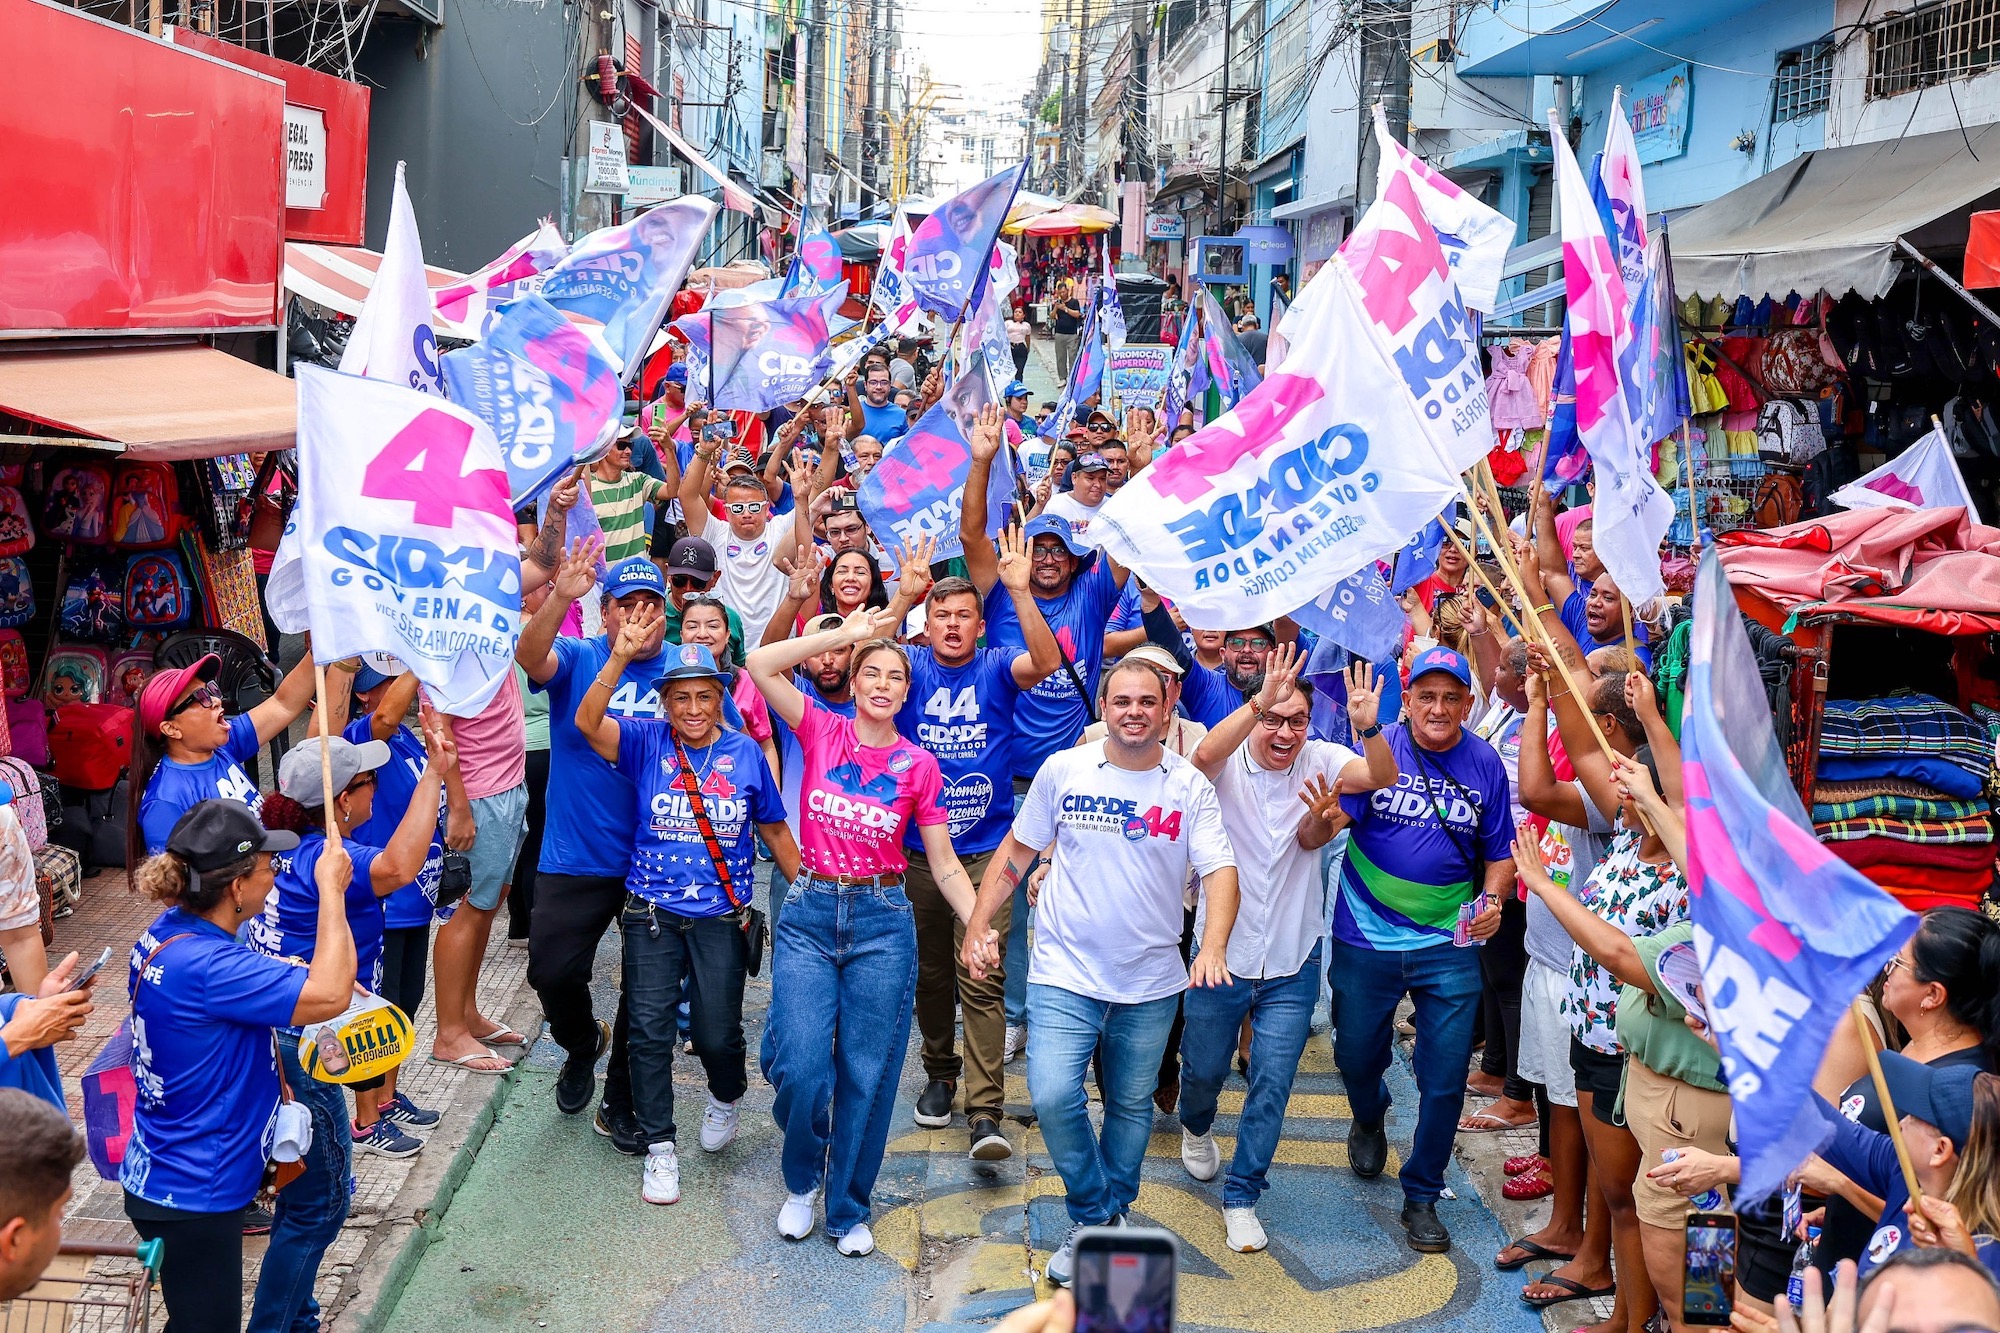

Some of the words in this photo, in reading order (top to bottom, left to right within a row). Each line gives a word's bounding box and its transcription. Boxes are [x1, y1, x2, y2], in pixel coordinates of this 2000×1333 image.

[285, 121, 309, 146] EGAL
[286, 149, 315, 173] PRESS
[629, 175, 677, 187] Mundinho
[1156, 217, 1176, 225] Baby
[1158, 224, 1177, 232] Toys
[1113, 349, 1165, 360] PROMOÇÃO
[1111, 359, 1165, 371] IMPERDÍVEL
[1115, 373, 1161, 391] 50%
[322, 525, 522, 613] CIDAD
[619, 572, 658, 583] CIDADE
[622, 565, 654, 574] #TIME
[375, 602, 398, 622] VICE
[1424, 650, 1458, 668] 44
[924, 684, 981, 725] 44
[917, 722, 988, 744] CIDADE
[919, 741, 987, 752] GOVERNADOR
[824, 760, 901, 807] 44
[1395, 772, 1483, 807] OBERTO
[651, 793, 748, 822] CIDADE
[808, 788, 902, 835] CIDADE
[952, 799, 969, 807] povo
[1062, 795, 1138, 818] CIDADE
[1075, 822, 1099, 831] SERAFIM
[1141, 805, 1182, 842] 44
[657, 831, 677, 841] Vice
[677, 832, 706, 844] Serafi
[363, 1041, 401, 1063] RODRIGO
